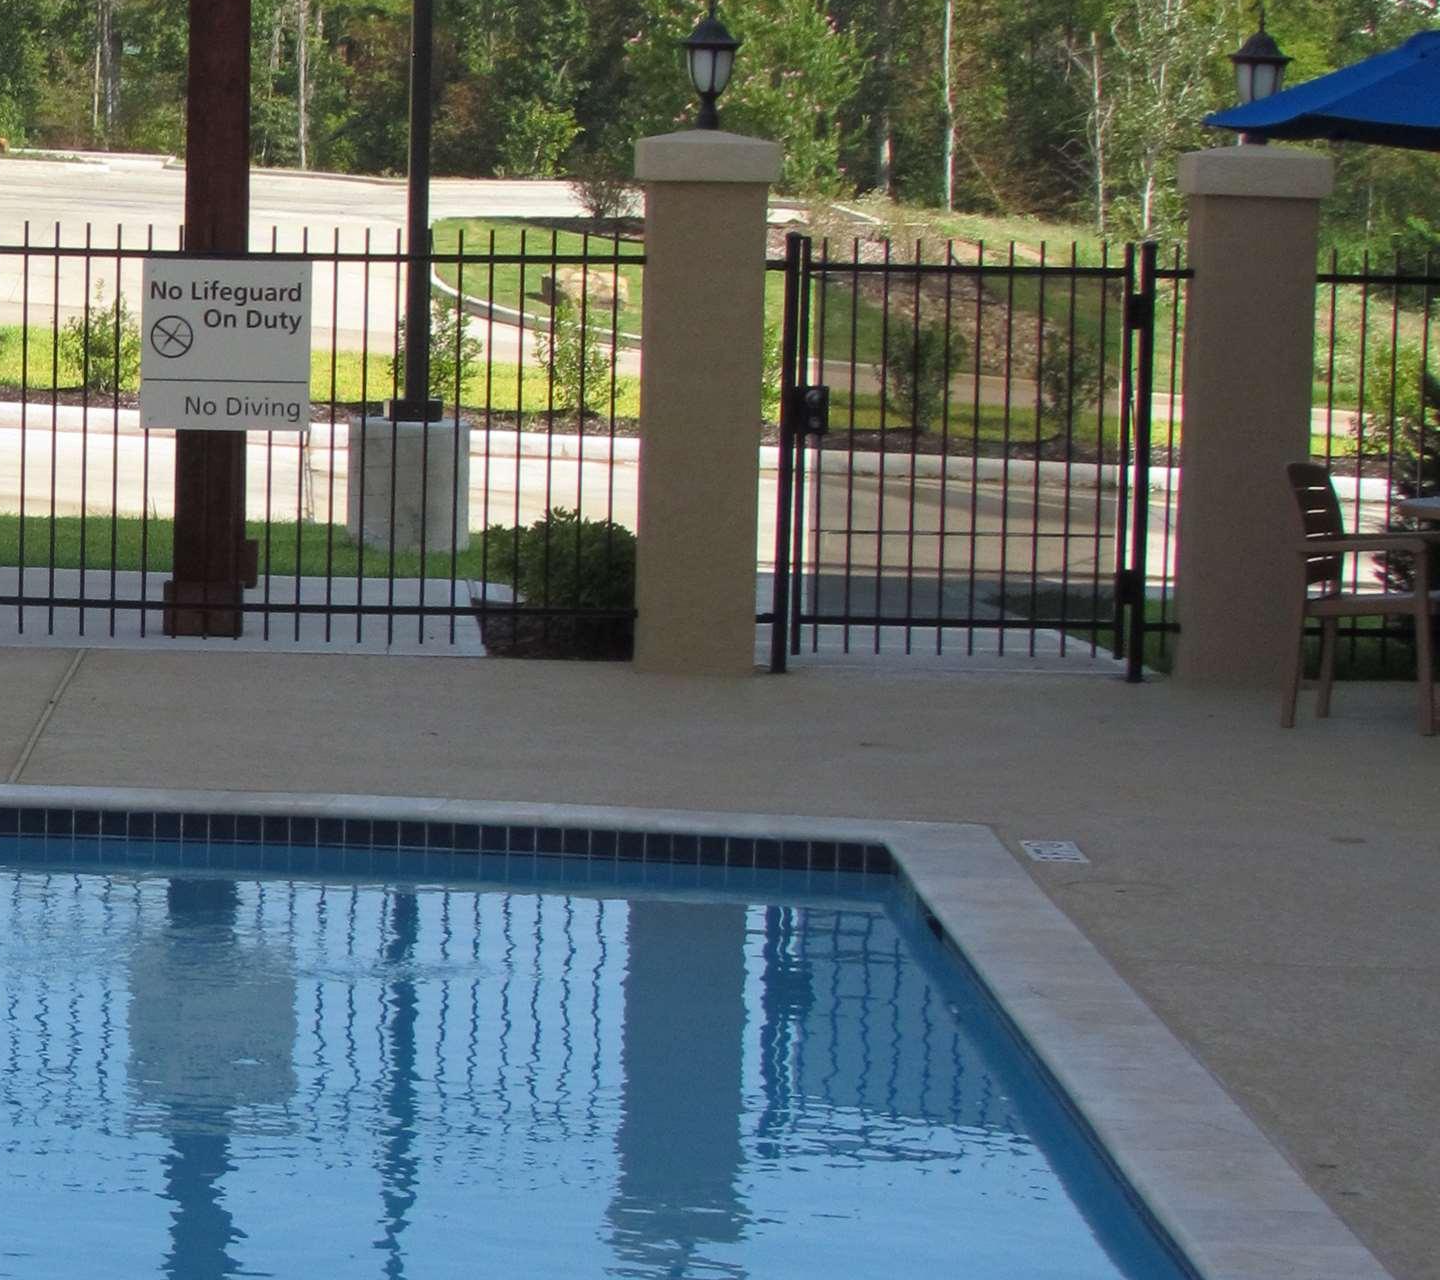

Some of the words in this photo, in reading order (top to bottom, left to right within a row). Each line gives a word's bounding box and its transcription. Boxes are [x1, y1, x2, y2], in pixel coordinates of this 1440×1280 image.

[150, 281, 182, 300] No
[191, 281, 302, 306] Lifeguard
[203, 309, 236, 328] On
[246, 310, 302, 335] Duty
[185, 397, 216, 415] No
[226, 397, 300, 422] Diving
